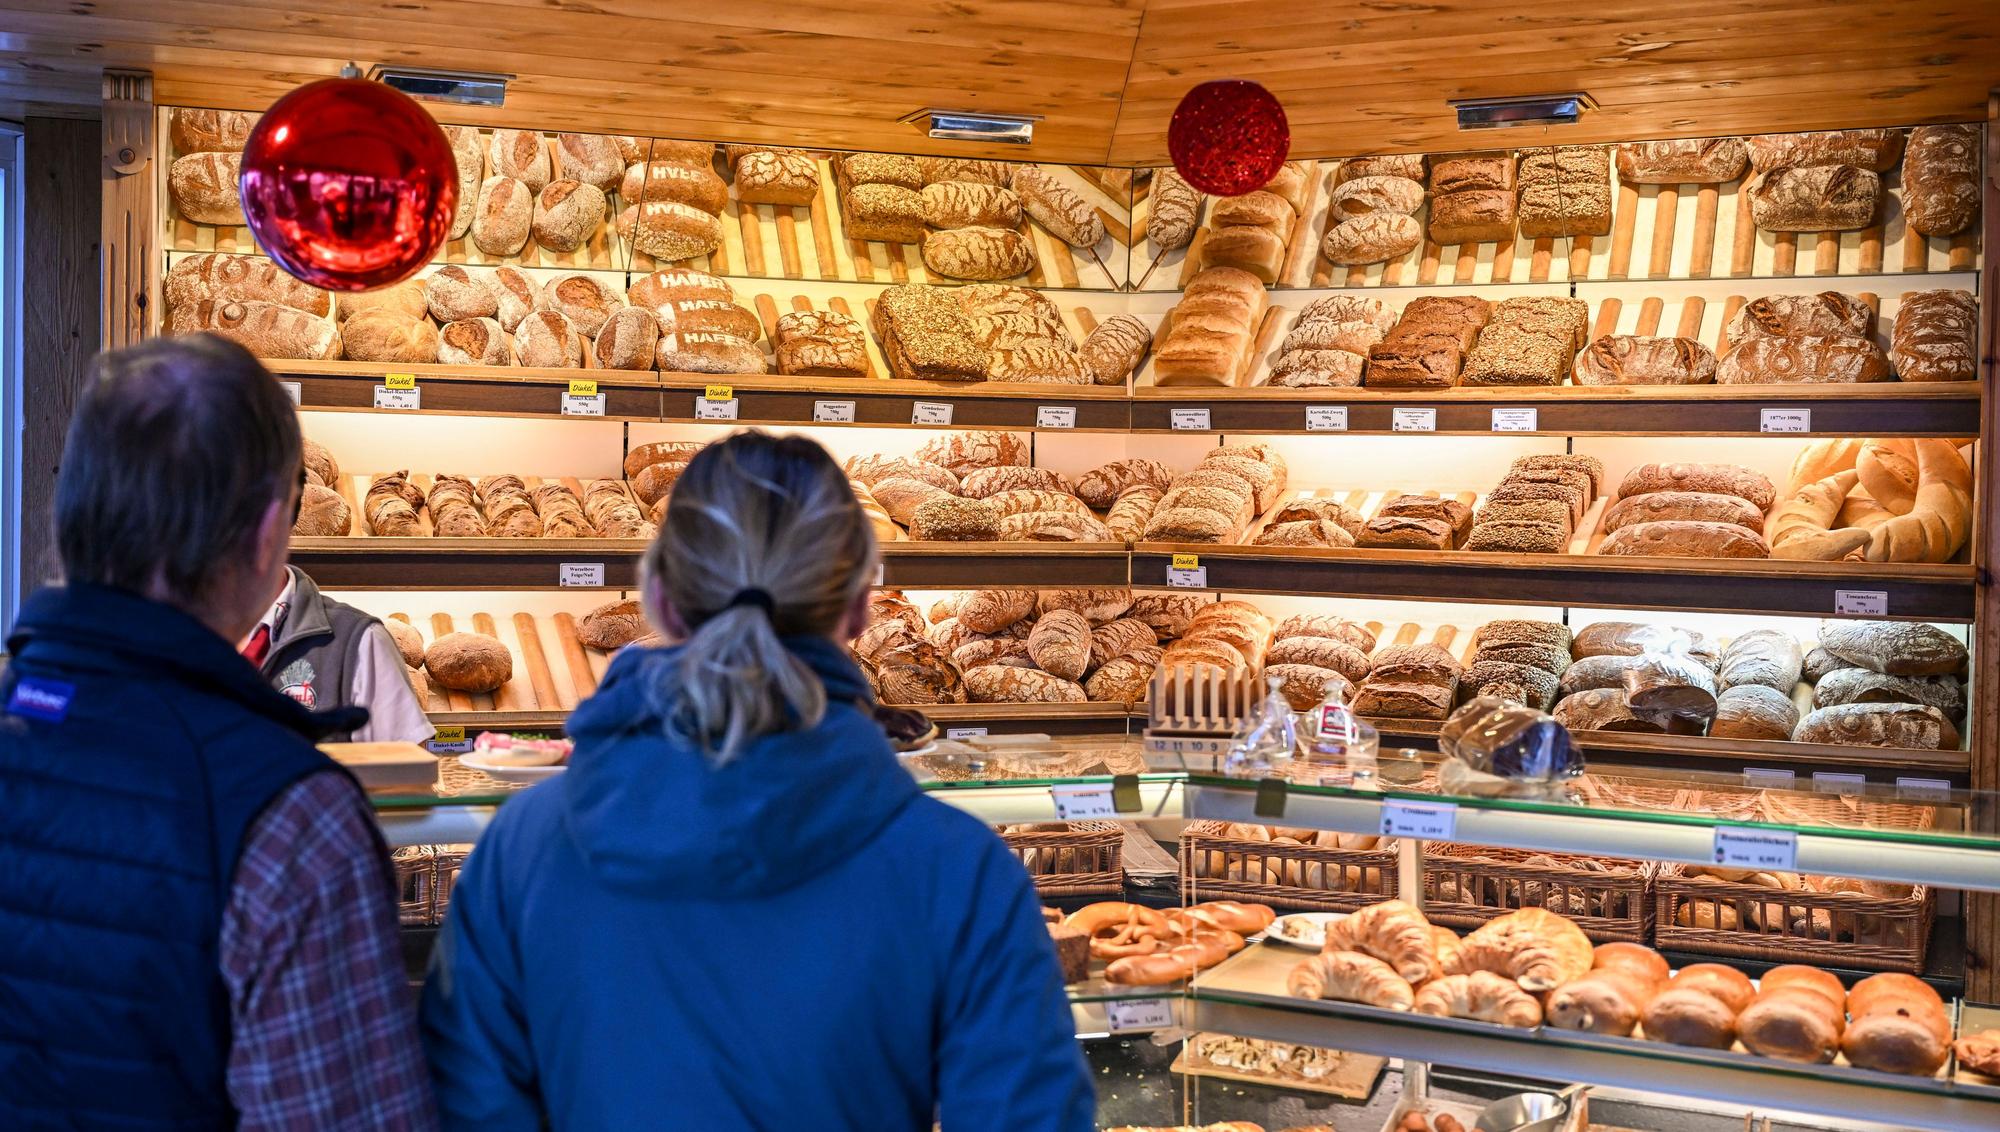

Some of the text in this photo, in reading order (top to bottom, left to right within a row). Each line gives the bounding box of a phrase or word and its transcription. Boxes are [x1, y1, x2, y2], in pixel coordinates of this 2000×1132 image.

[389, 378, 410, 386] Dinkel
[572, 384, 594, 392] Dinkel
[709, 388, 729, 396] Dinkel
[439, 730, 461, 738] Dinkel
[1155, 740, 1218, 751] 12 11 10 9
